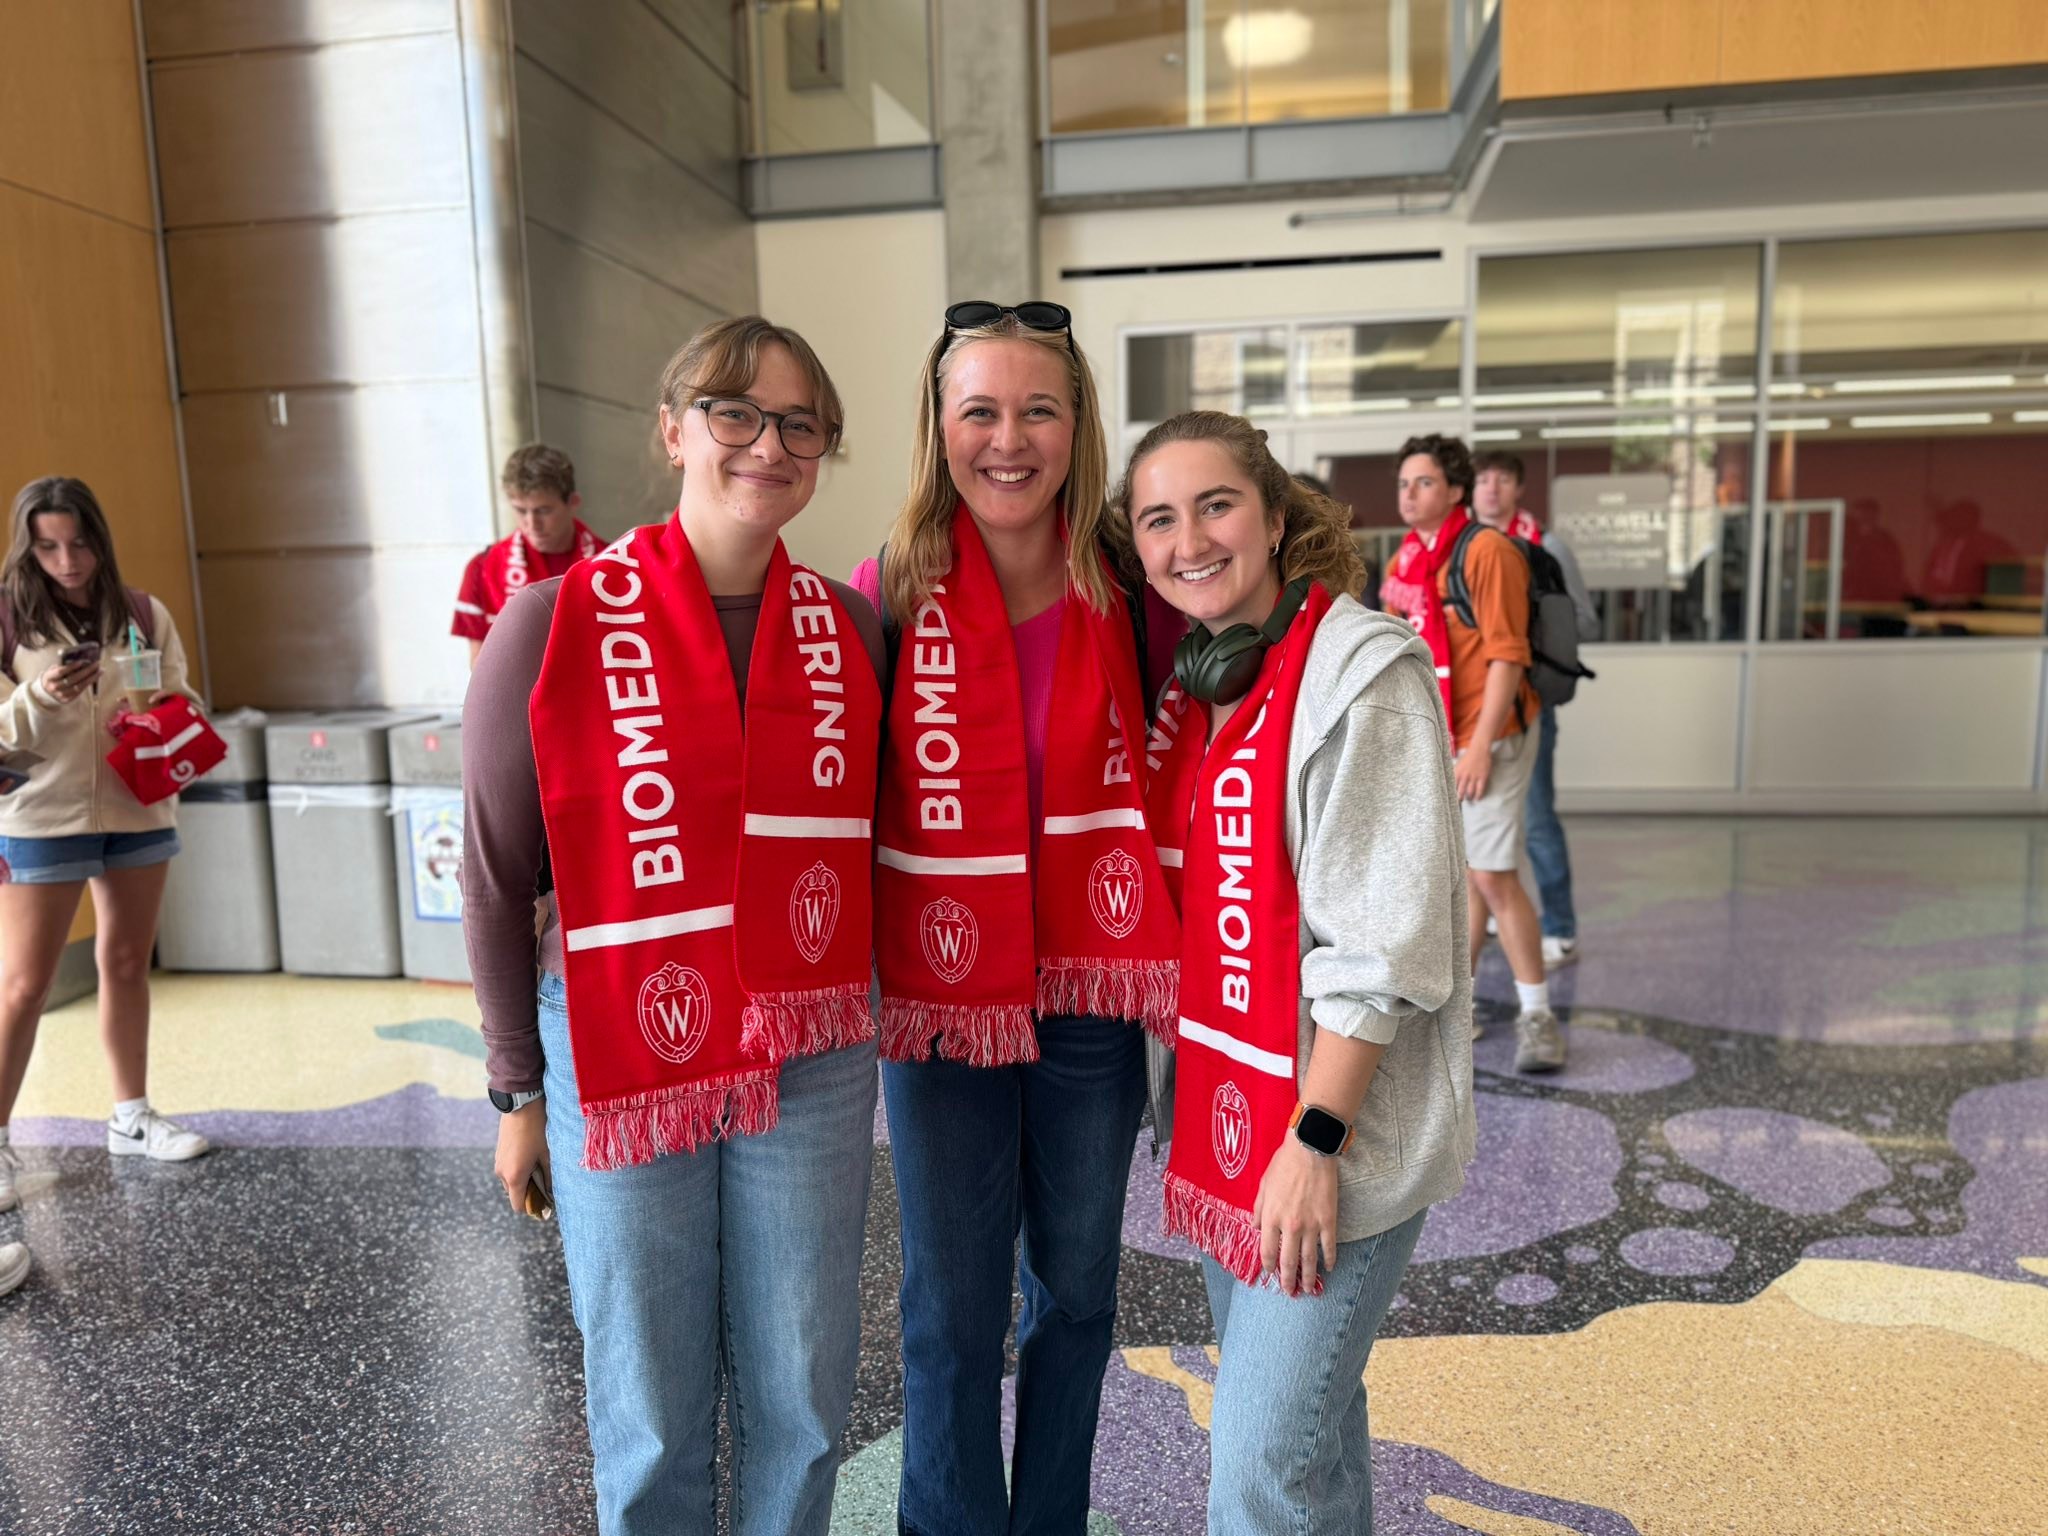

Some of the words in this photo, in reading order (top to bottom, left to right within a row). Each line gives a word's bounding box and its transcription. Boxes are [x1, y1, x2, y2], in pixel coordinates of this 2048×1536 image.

[804, 894, 828, 941] W
[1103, 879, 1132, 919] W
[934, 923, 963, 964] W
[655, 995, 692, 1042] W
[1221, 1111, 1242, 1158] W
